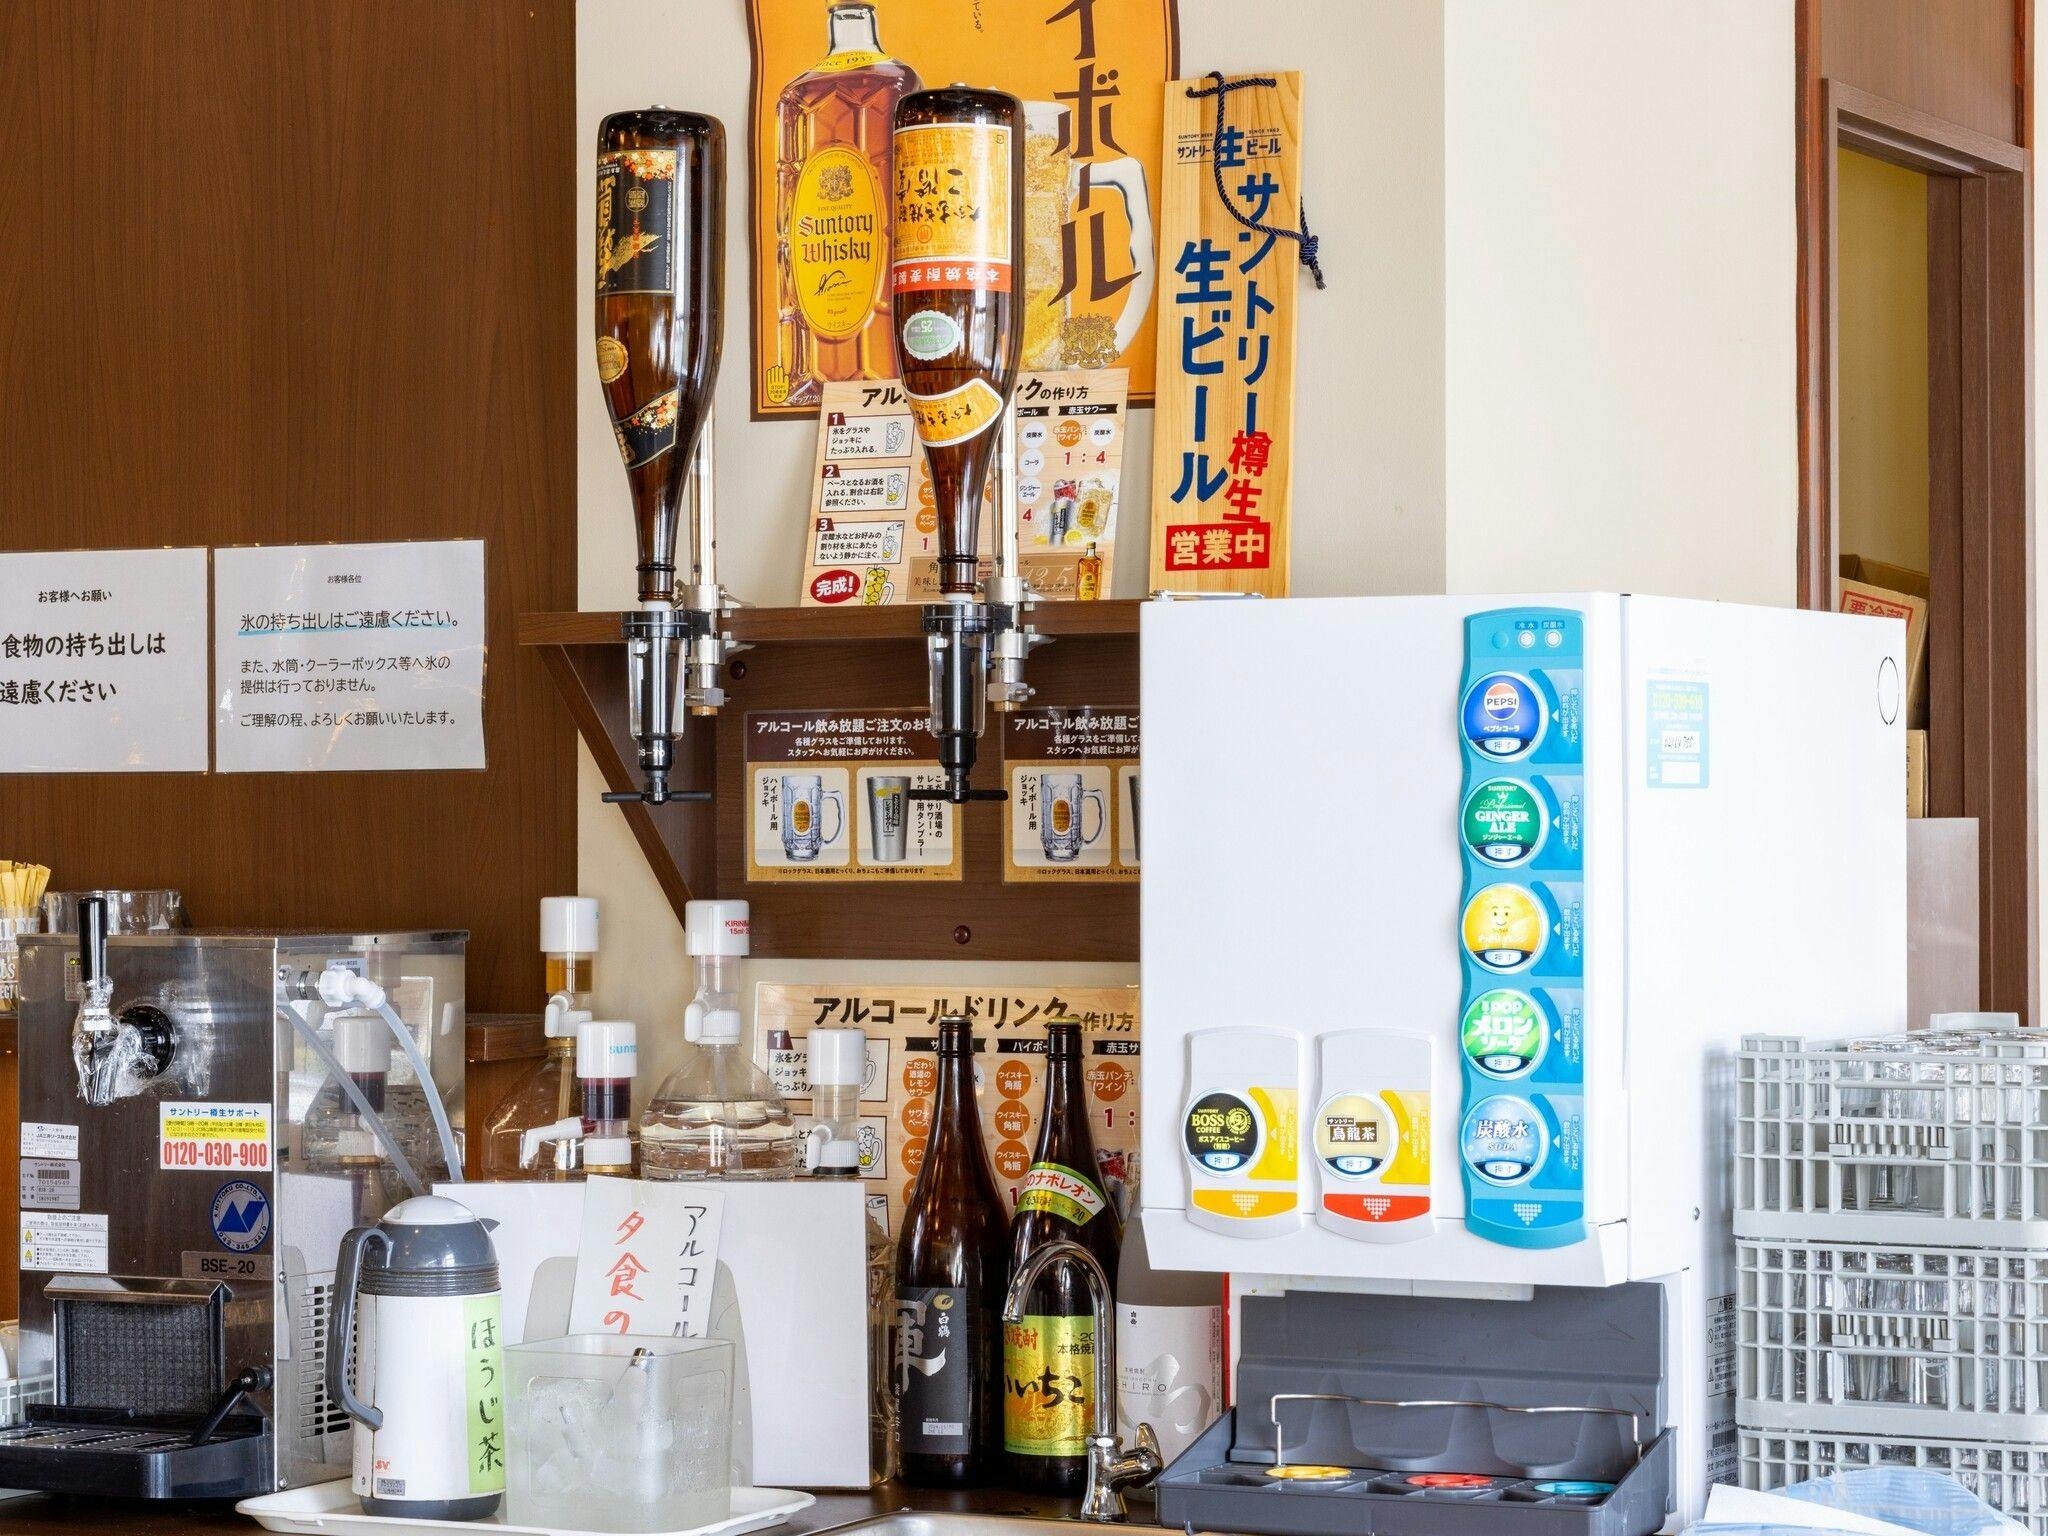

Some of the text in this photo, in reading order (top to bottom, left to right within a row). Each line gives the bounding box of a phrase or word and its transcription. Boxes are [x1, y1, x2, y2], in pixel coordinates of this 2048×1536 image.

[1177, 144, 1212, 159] サントリー
[1246, 138, 1281, 156] ビール
[799, 213, 873, 238] Suntory
[801, 236, 871, 264] Whisky
[1236, 172, 1280, 437] サントリー
[920, 320, 933, 333] 25
[1169, 238, 1232, 504] 生ビール
[862, 386, 908, 408] アル
[1068, 405, 1108, 415] 赤玉サワー
[831, 413, 839, 424] 1
[832, 427, 871, 435] 氷をグラスや
[831, 436, 862, 445] ジョッキに
[830, 445, 879, 455] たっぷり入れる。
[825, 466, 835, 477] 2
[1223, 429, 1273, 524] 樽生
[828, 478, 885, 487] ベースとなるお酒を
[826, 487, 885, 498] 入れる。割合は右記
[825, 498, 867, 507] 参照ください。
[1022, 508, 1034, 522] 4
[819, 519, 829, 532] 3
[820, 531, 882, 541] 炭酸水などお好みの
[820, 542, 879, 551] 割り材を氷にあたら
[922, 536, 930, 551] 1
[1169, 527, 1266, 566] 営業中
[819, 551, 881, 560] ないよう静かに注ぐ。
[327, 573, 363, 585] お客様各位
[816, 576, 854, 598] 完成!
[37, 589, 113, 604] お客様へお願い
[240, 609, 459, 633] 氷の持ち出しはご遠慮ください。
[2, 632, 167, 659] 食物の持ち出しは
[240, 655, 452, 675] また、水筒・クーラーボックス等へ氷の
[0, 679, 118, 706] 遠慮ください
[240, 677, 378, 696] 提供は行っておりません。
[1486, 697, 1517, 707] PEPSI
[240, 710, 458, 729] ご理解の程、よろしくお願いいたします。
[1014, 716, 1139, 731] アルコール飲み放題ご
[1482, 725, 1520, 733] ペプシコーラ
[795, 736, 908, 748] 各種グラスをご準備しております。
[787, 748, 915, 758] スタッフへお気軽にお声がけください。
[761, 776, 770, 807] ジョッキ
[1019, 775, 1028, 806] ジョッキ
[769, 777, 779, 831] ハイボール用
[934, 775, 943, 838] こだり酒場の
[1028, 775, 1038, 831] ハイボール用
[916, 775, 925, 856] サワ用タンブラー
[1475, 810, 1531, 823] GINGER
[1488, 822, 1518, 834] ALE
[1482, 833, 1523, 842] ジンジャーエール
[1471, 1014, 1533, 1036] メロン
[773, 1032, 781, 1048] 1
[1480, 1035, 1524, 1053] ソーダ
[1105, 1042, 1140, 1055] 赤玉サ
[906, 1060, 936, 1070] こだわり
[775, 1067, 808, 1078] ジョッキ
[909, 1070, 932, 1079] 酒場の
[998, 1071, 1030, 1080] ウイスキー
[1086, 1069, 1133, 1081] 赤玉パンチ
[909, 1079, 931, 1088] レモン
[1004, 1080, 1023, 1091] 角瓶
[1092, 1081, 1127, 1092] (ワイン)
[909, 1088, 931, 1097] サワー
[169, 1108, 260, 1118] サントリー樽生サポート
[996, 1111, 1029, 1120] ウイスキー
[908, 1119, 930, 1128] ベース
[1003, 1121, 1022, 1132] 角瓶
[1191, 1113, 1226, 1127] BOSS
[1195, 1126, 1221, 1134] COFFEE
[1331, 1125, 1377, 1143] 烏龍茶
[1476, 1119, 1529, 1139] 炭酸水
[1198, 1135, 1246, 1143] ボスアイスコーヒー
[1487, 1142, 1518, 1151] SODA
[163, 1141, 268, 1168] 0120-030-900
[996, 1151, 1029, 1159] ウイスキー
[1003, 1161, 1022, 1172] 角瓶
[1072, 1207, 1086, 1221] 20
[201, 1258, 256, 1274] BSE-20
[674, 1204, 708, 1338] アルコール
[603, 1209, 650, 1337] 夕食の
[471, 1316, 502, 1474] ほうじ茶
